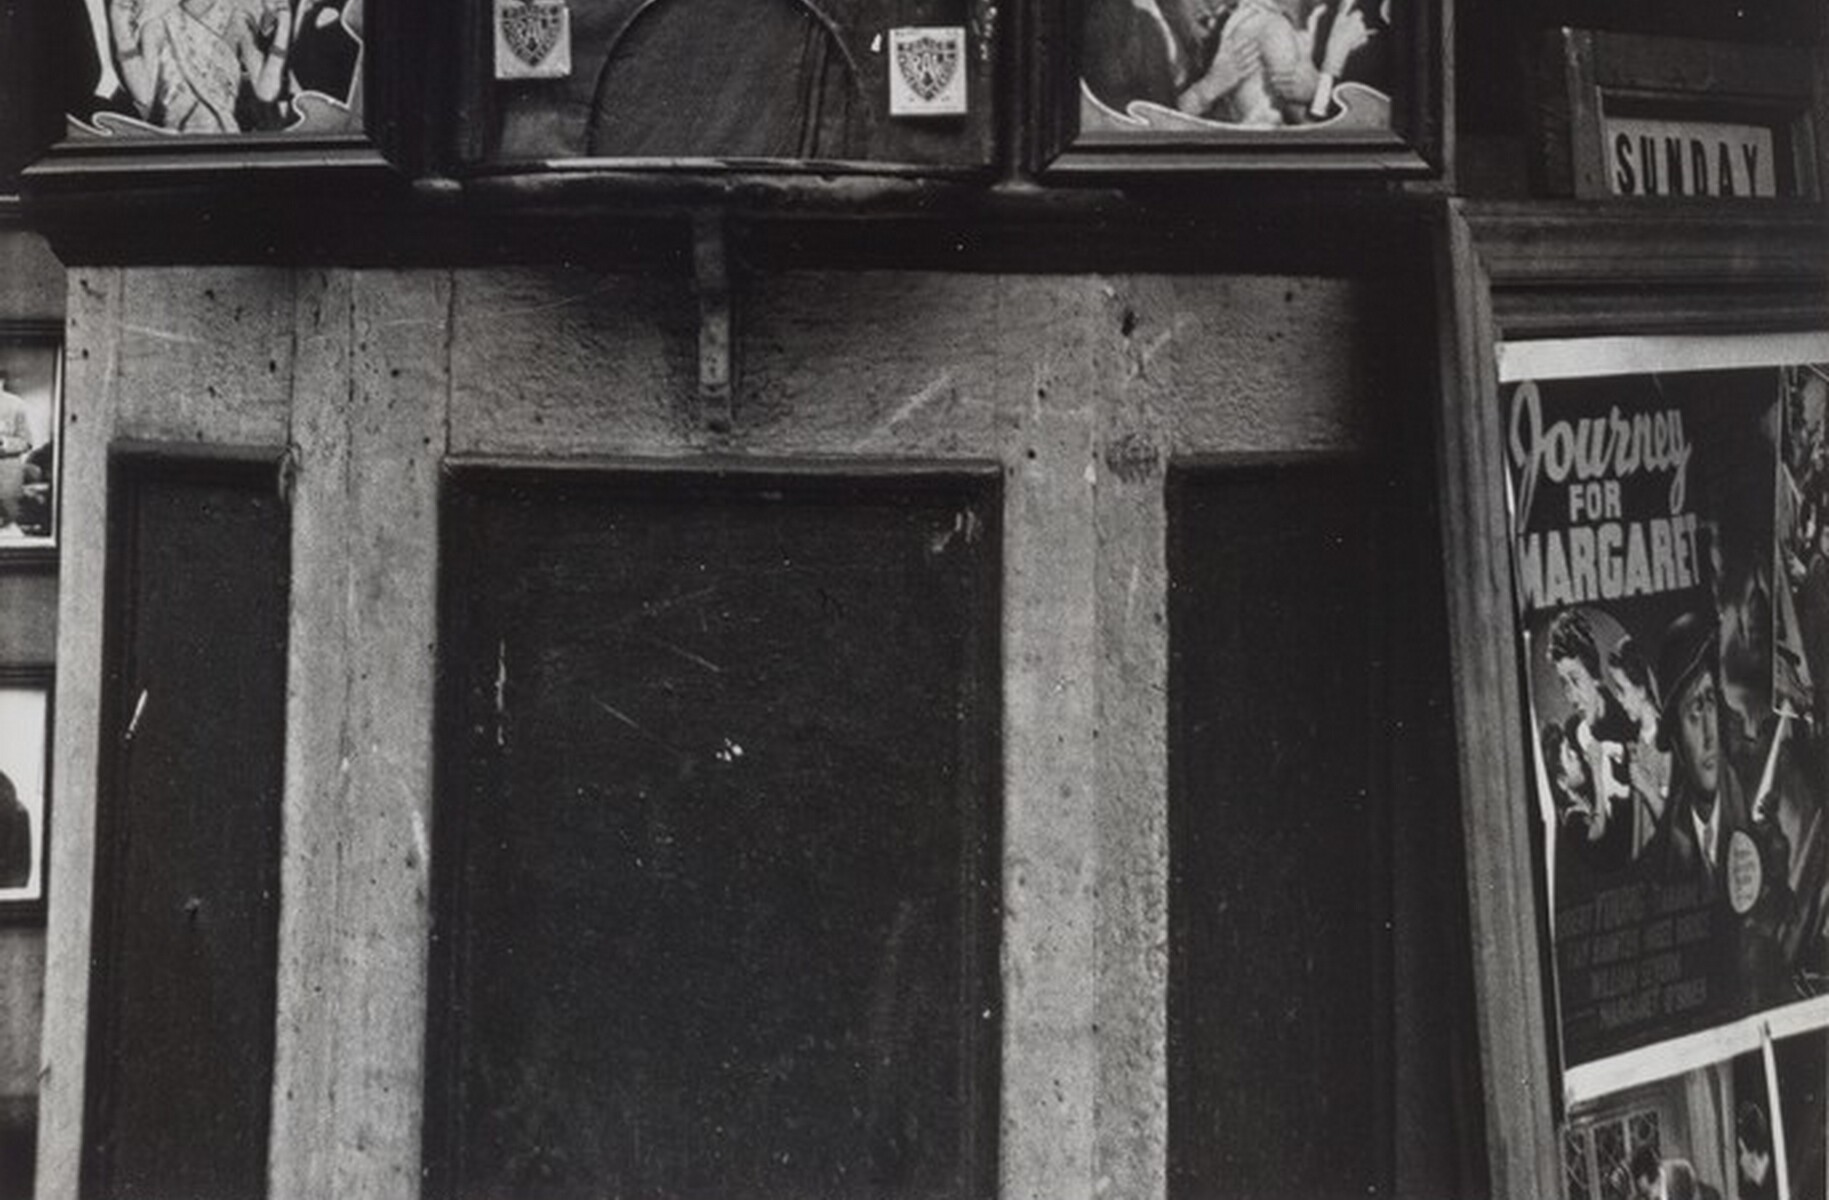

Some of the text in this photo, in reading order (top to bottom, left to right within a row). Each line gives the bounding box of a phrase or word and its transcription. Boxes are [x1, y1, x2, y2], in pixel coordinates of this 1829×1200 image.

[1613, 131, 1760, 196] SUNDAY
[1509, 380, 1692, 535] Journey
[1568, 479, 1622, 523] FOR
[1517, 512, 1701, 609] MARGARET
